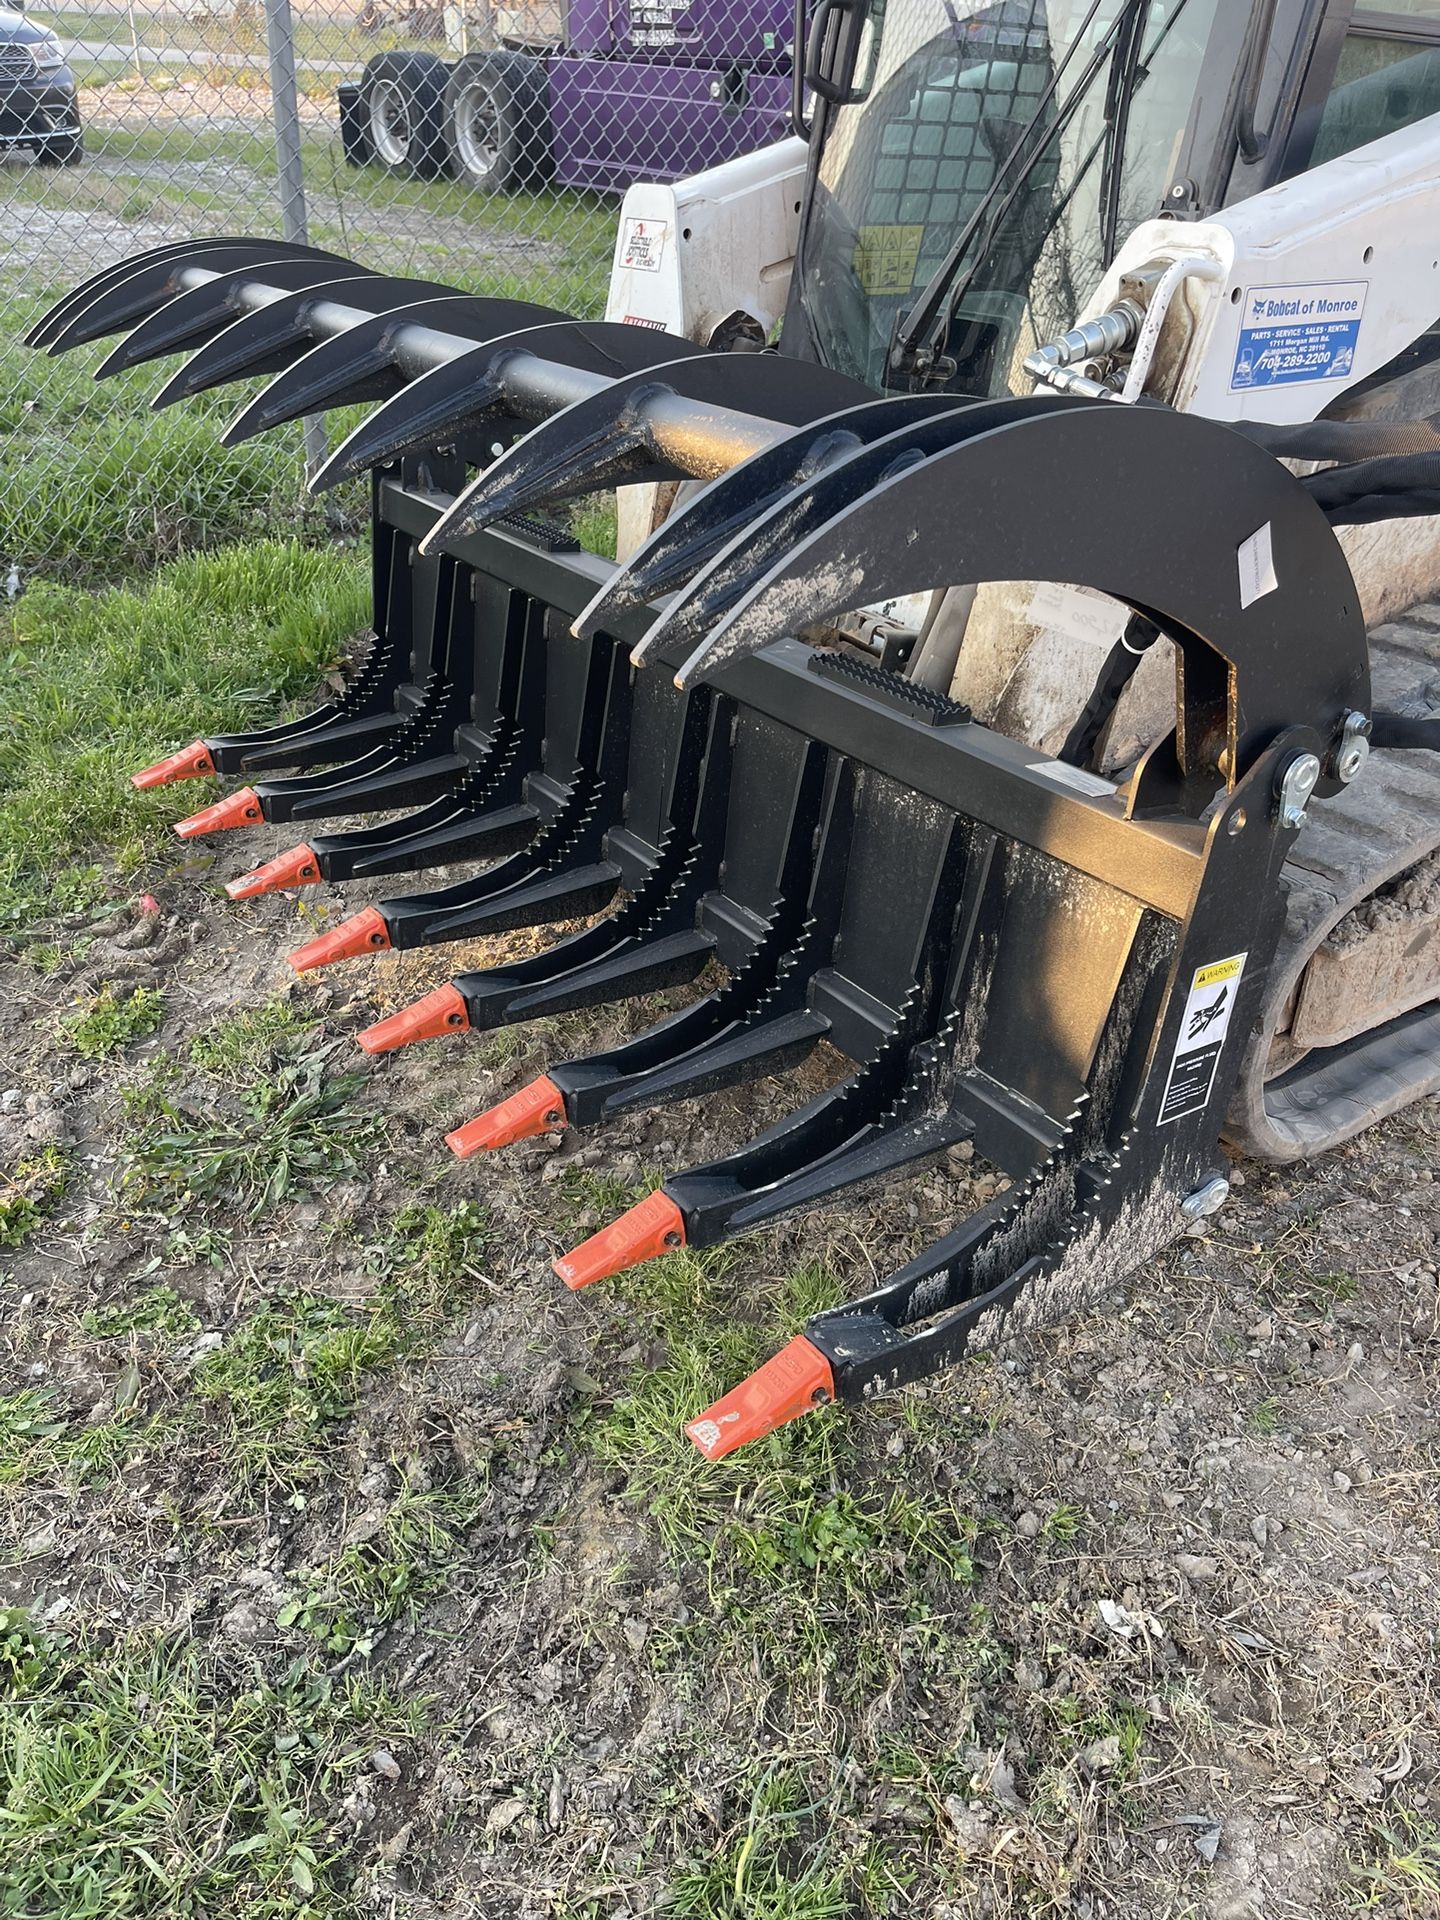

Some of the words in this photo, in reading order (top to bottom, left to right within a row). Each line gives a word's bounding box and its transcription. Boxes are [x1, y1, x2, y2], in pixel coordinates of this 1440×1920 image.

[1266, 299, 1300, 317] Bobcat
[1302, 300, 1314, 314] of
[1316, 299, 1358, 314] Monroe
[624, 317, 665, 331] AUTOMATIC
[1251, 331, 1271, 340] PARTS
[1275, 328, 1300, 338] SERVICE
[1305, 326, 1324, 335] SALES
[1327, 324, 1349, 333] RENTAL
[1269, 339, 1284, 347] 1711
[1285, 338, 1308, 346] Morgan
[1261, 351, 1331, 370] 704-289-2200
[1206, 961, 1240, 979] WARNING
